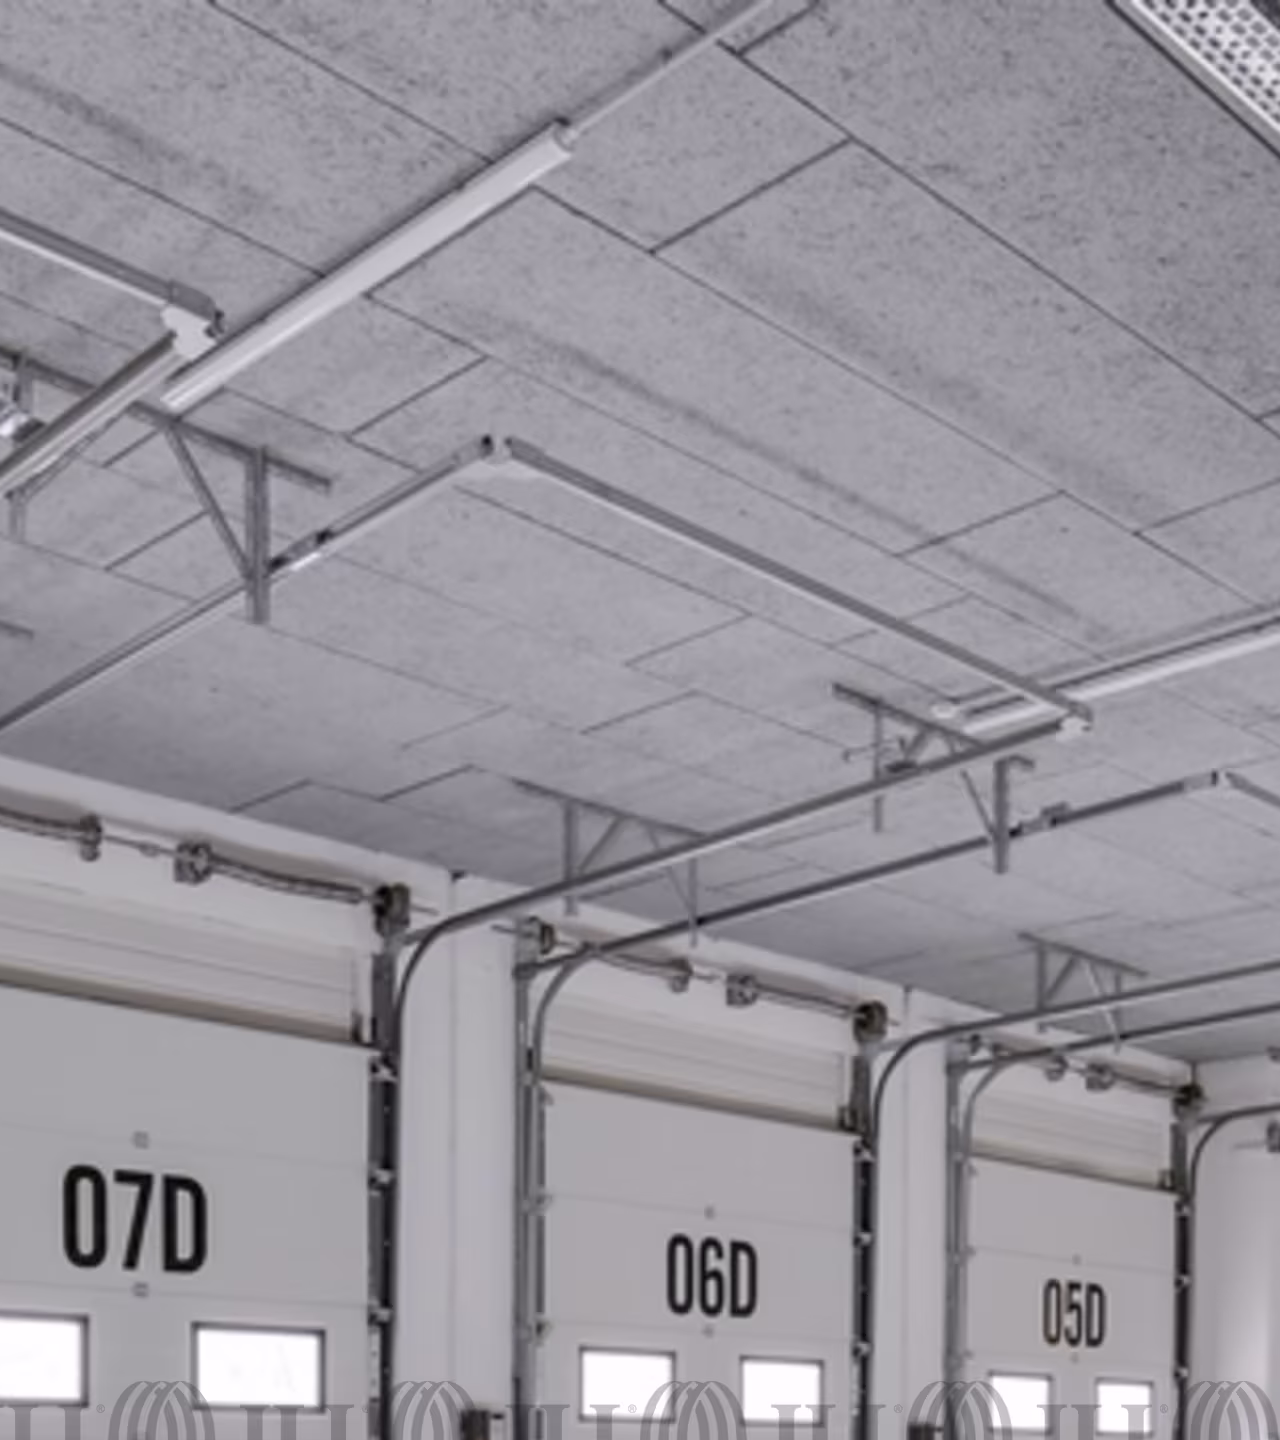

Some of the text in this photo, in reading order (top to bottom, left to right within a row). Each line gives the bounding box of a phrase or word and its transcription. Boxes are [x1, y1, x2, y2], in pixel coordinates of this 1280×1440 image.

[62, 1164, 208, 1274] 07D
[666, 1233, 758, 1318] 06D
[1043, 1278, 1106, 1347] 05D
